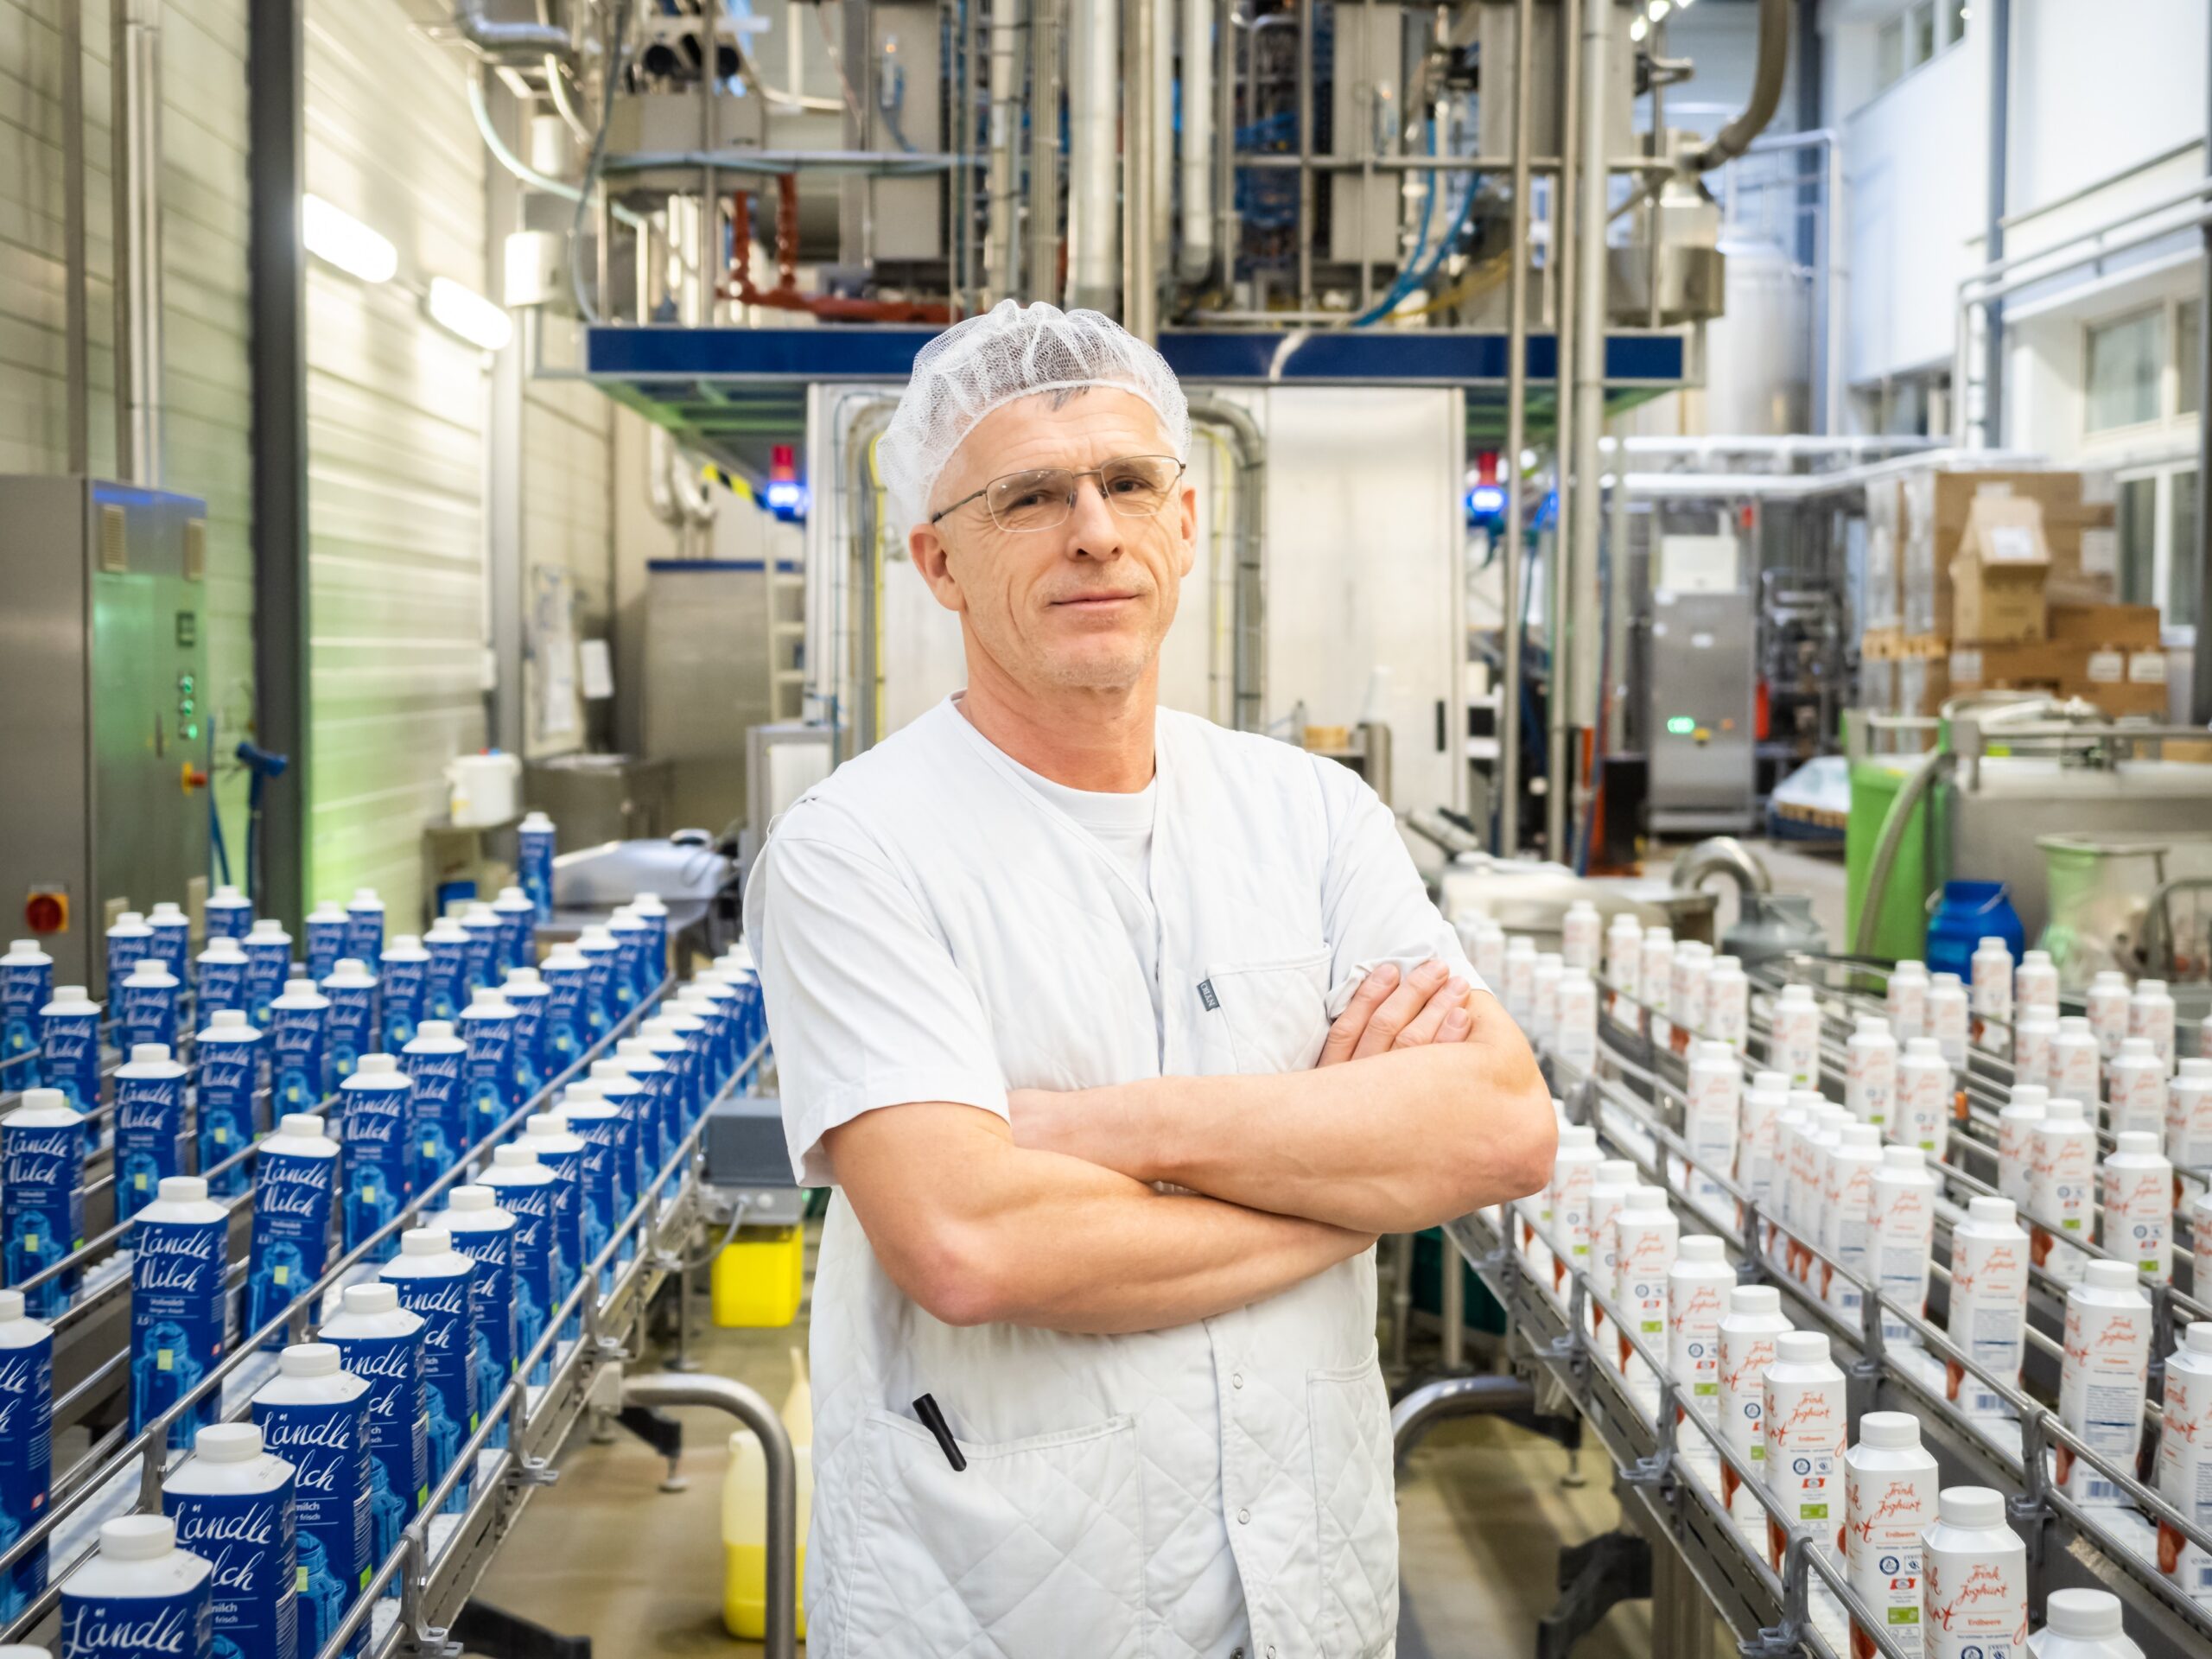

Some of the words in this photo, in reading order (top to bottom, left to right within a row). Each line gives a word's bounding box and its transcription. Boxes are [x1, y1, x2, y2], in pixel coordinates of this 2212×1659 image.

[134, 1226, 214, 1262] Ländle
[136, 1257, 207, 1292] Milch
[399, 1282, 463, 1313] ändle
[340, 1344, 410, 1378] ändle
[1797, 1390, 1825, 1408] Trink
[260, 1410, 353, 1449] Ländle
[1788, 1407, 1831, 1426] Joghurt
[1885, 1480, 1916, 1500] Trink
[172, 1502, 274, 1545] Ländle
[1874, 1497, 1922, 1520] Joghurt
[1967, 1563, 2001, 1584] Trink
[1955, 1582, 2009, 1606] Joghurt
[61, 1605, 188, 1659] Ländle
